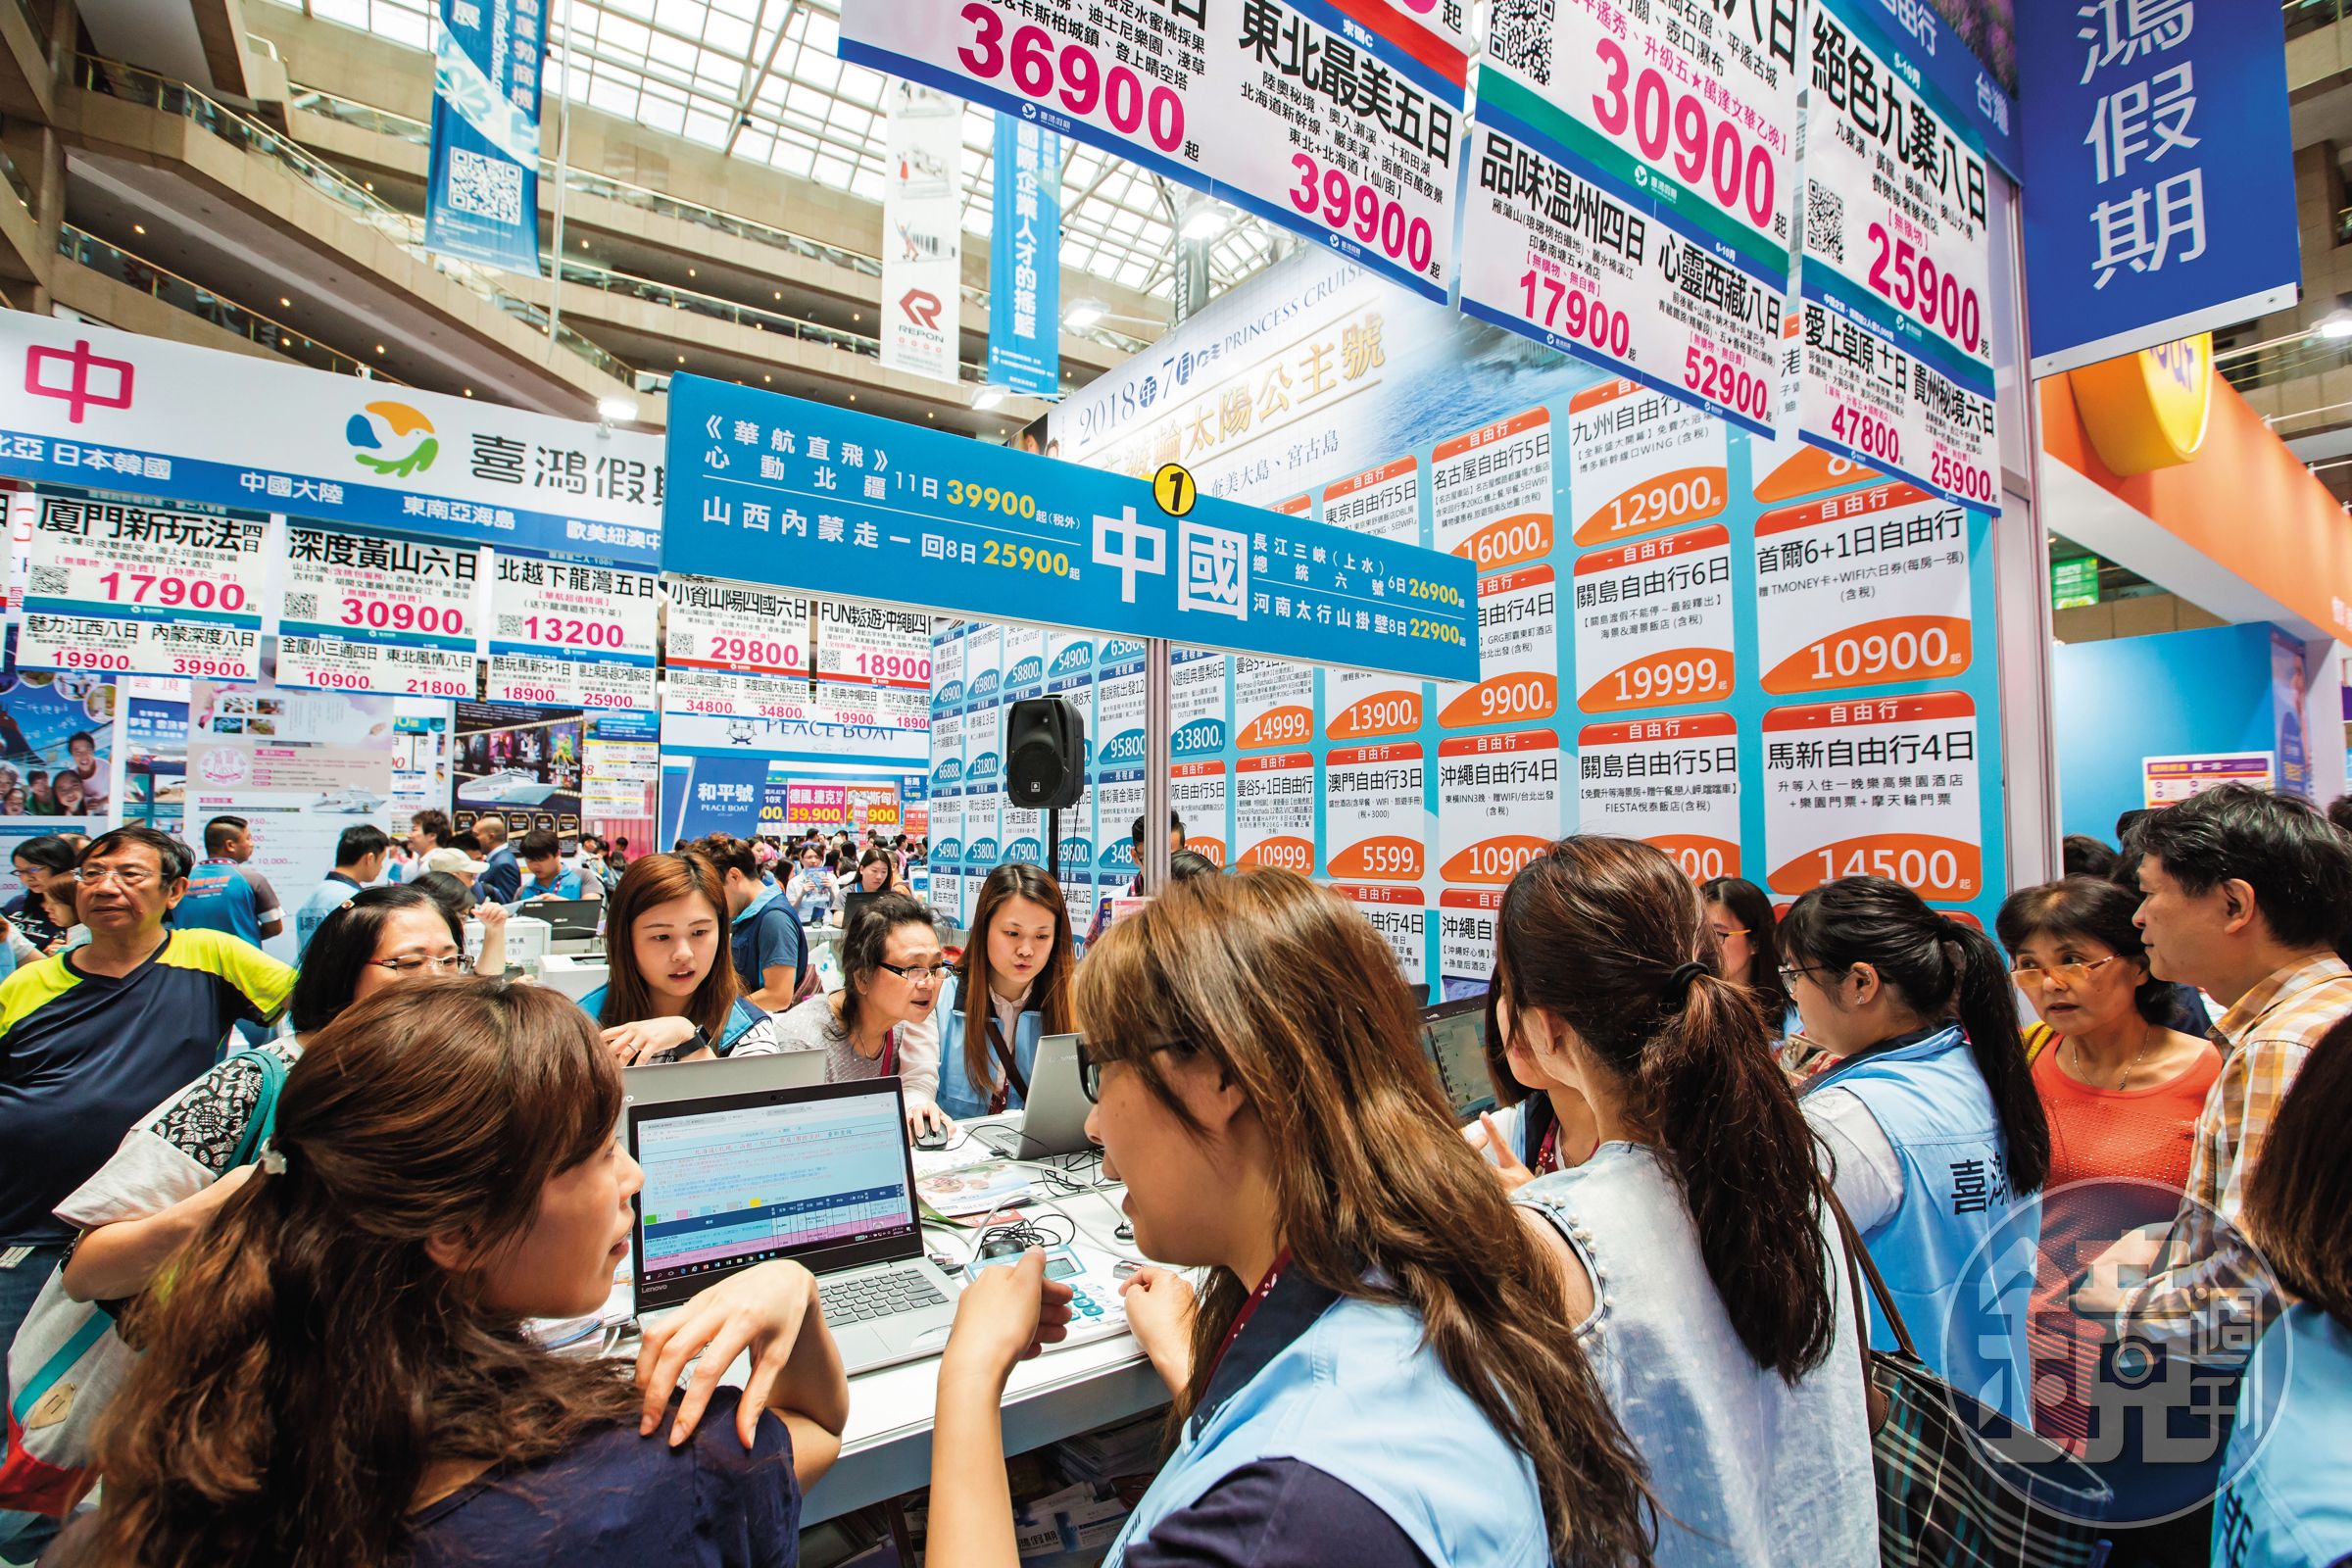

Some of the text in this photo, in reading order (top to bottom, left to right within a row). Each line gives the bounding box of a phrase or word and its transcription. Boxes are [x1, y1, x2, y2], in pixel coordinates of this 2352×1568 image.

[957, 2, 1185, 153] 36900
[1239, 0, 1452, 169] 東北最美五日
[1592, 37, 1774, 228] 30900
[1812, 10, 1986, 231] 絕色九寨八日
[2077, 0, 2207, 291] 鴻假期
[1289, 153, 1432, 272] 39900
[1658, 233, 1781, 339] 心靈西藏八日
[1868, 221, 1980, 353] 25900
[1225, 298, 1298, 353] PRINCESS
[1519, 270, 1630, 359] 17900
[899, 324, 944, 343] REPON
[24, 339, 134, 423] 中
[1684, 346, 1767, 422] 52900
[705, 414, 889, 473] 《華航直飛》
[1470, 421, 1509, 447] 自由行
[1832, 404, 1899, 464] 47800
[53, 443, 172, 481] 日本韓國
[1434, 433, 1550, 490] 名古屋自由行5日
[1932, 451, 1991, 502] 25900
[240, 471, 344, 505] 中國大陸
[705, 445, 887, 501] 心動北疆
[947, 478, 1036, 519] 39900
[1353, 467, 1386, 489] 自由行
[403, 495, 515, 530] 東南亞海島
[1325, 478, 1416, 525] 東京自由行5日
[1609, 476, 1711, 531] 12900
[1821, 487, 1889, 519] 自由行
[288, 528, 477, 581] 深度黃山六日
[1463, 521, 1541, 563] 16000
[1624, 537, 1674, 563] 自由行
[1757, 507, 1964, 575] 首爾6+1日自由行
[983, 539, 1069, 578] 25900
[1092, 505, 1249, 622] 中國
[99, 571, 245, 612] 17900
[498, 558, 654, 599] 北越下龍灣五日
[1409, 577, 1458, 606] 26900
[1576, 556, 1730, 610] 關島自由行6日
[340, 598, 463, 634] 30900
[670, 585, 807, 620] 小資山陽四國六日
[26, 614, 138, 639] 魅力江西八日
[524, 615, 623, 648] 13200
[1409, 617, 1459, 646] 22900
[52, 651, 130, 670] 19900
[710, 637, 799, 666] 29800
[856, 653, 930, 680] 18900
[1058, 647, 1088, 670] 54900
[1811, 626, 1948, 680] 10900
[172, 659, 245, 677] 39900
[306, 671, 369, 689] 10900
[1012, 661, 1039, 682] 58800
[1614, 658, 1717, 702] 19999
[407, 679, 466, 696] 21800
[503, 687, 555, 703] 18900
[583, 693, 633, 708] 25900
[1481, 680, 1544, 716] 9900
[686, 699, 732, 714] 34800
[759, 706, 803, 718] 34800
[835, 711, 874, 724] 19900
[1349, 699, 1412, 731] 13900
[1830, 701, 1899, 724] 自由行
[1177, 725, 1219, 751] 33800
[1254, 713, 1305, 741] 14999
[1629, 720, 1681, 740] 自由行
[1357, 746, 1390, 760] 自由行
[1477, 736, 1516, 752] 自由行
[1768, 730, 1973, 770] 馬新自由行4日
[1182, 764, 1203, 775] 自由行
[1260, 756, 1286, 768] 自由行
[1441, 758, 1557, 788] 沖繩自由行4日
[1581, 747, 1737, 780] 關島自由行5日
[698, 783, 755, 803] 和平號
[1238, 776, 1312, 797] 曼谷5+1日自由行
[1328, 768, 1422, 793] 澳門自由行3日
[789, 809, 841, 823] 39,900
[1010, 844, 1038, 859] 47900
[1255, 845, 1305, 869] 10999
[1363, 846, 1414, 872] 5599
[1818, 849, 1958, 889] 14500
[1358, 887, 1392, 902] 自由行
[1362, 911, 1424, 935] 由行4日
[641, 1283, 667, 1294] Lenovo
